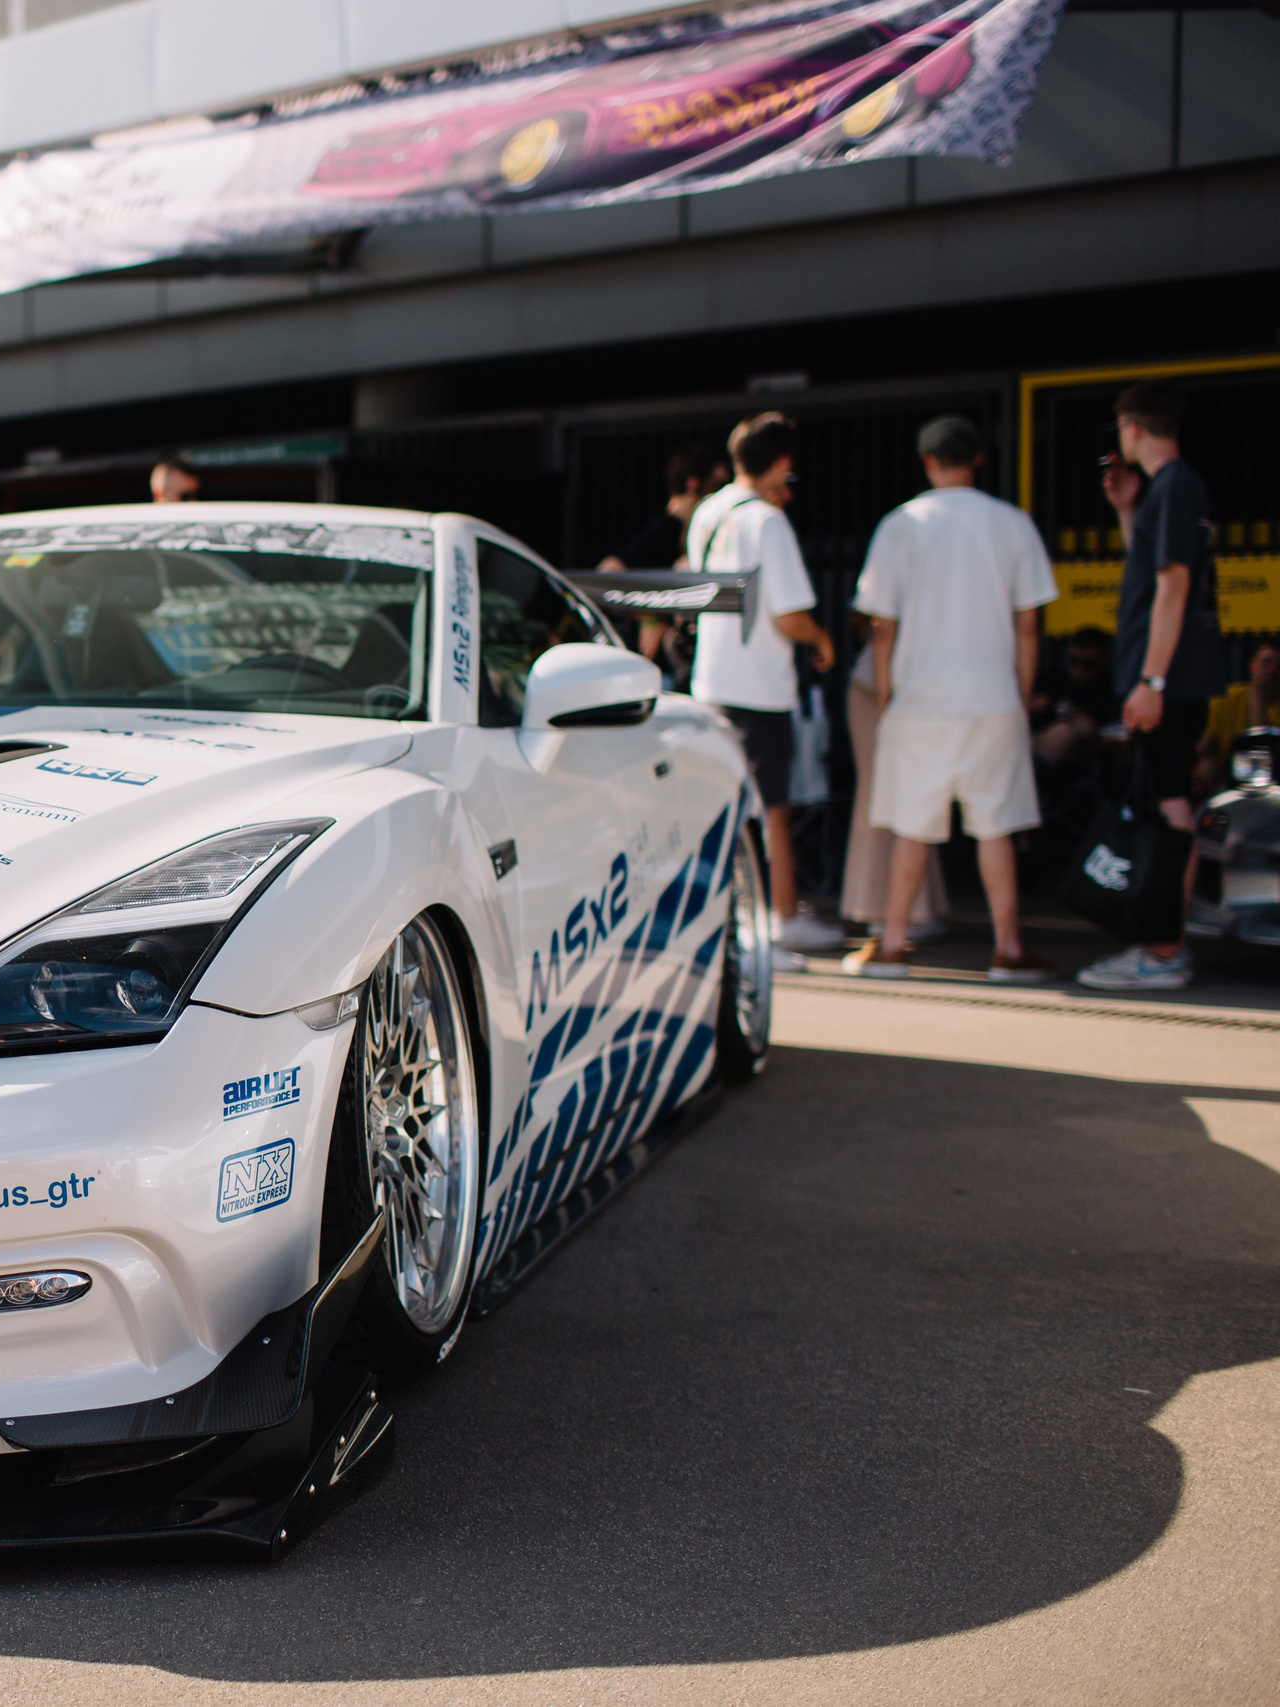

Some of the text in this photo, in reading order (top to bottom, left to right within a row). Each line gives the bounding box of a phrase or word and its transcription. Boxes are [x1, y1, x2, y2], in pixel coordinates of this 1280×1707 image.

[36, 758, 159, 787] HKS
[223, 1146, 291, 1201] NX
[221, 1183, 287, 1215] NITROUS EXPRESS
